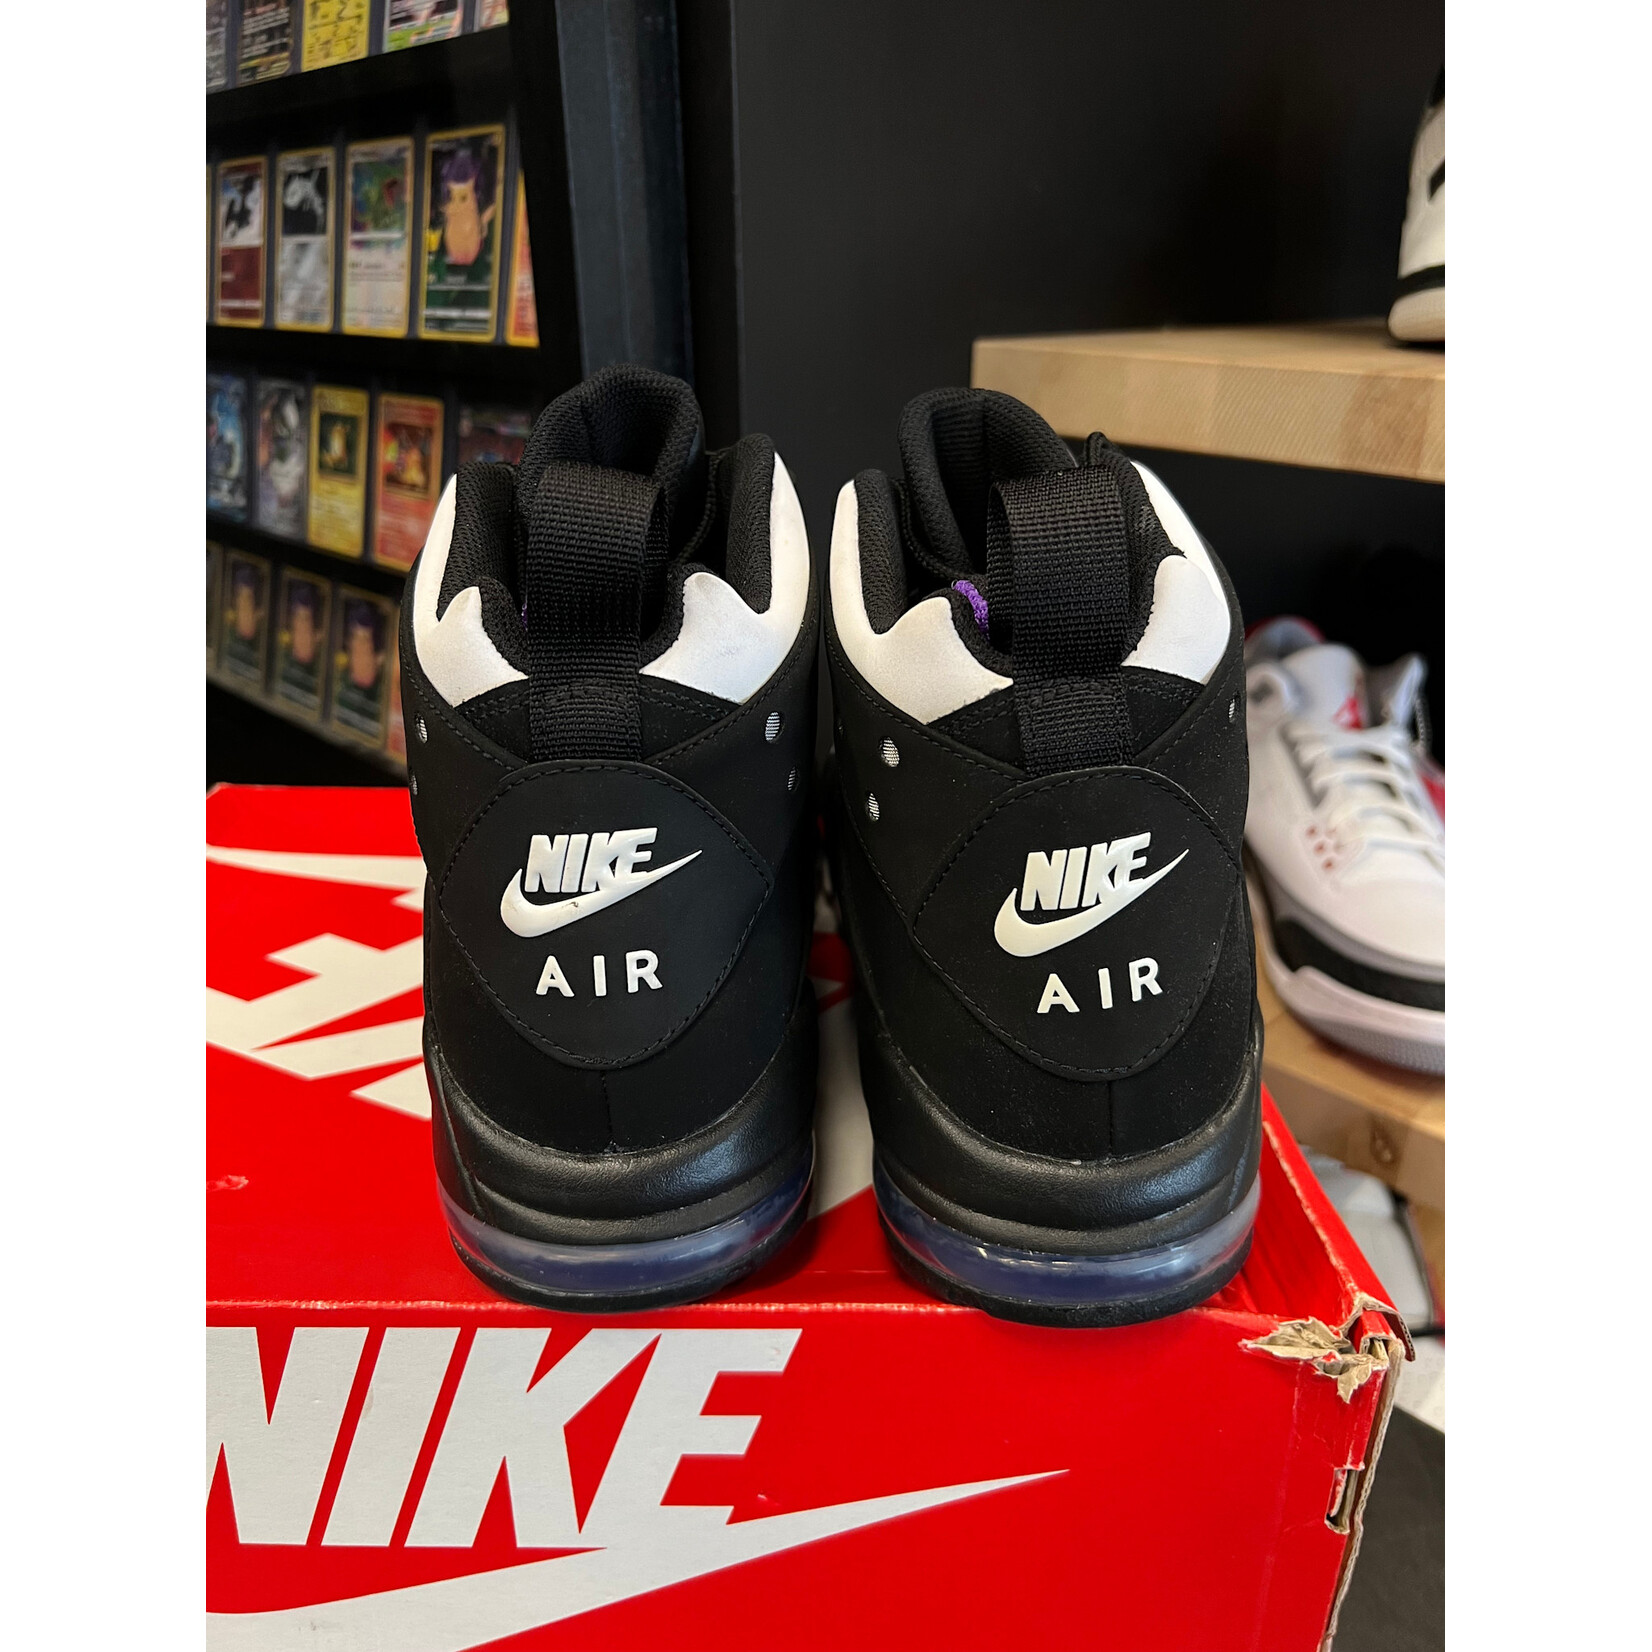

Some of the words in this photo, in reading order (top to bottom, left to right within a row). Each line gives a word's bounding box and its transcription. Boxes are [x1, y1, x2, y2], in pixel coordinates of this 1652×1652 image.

[524, 827, 658, 893] NIKE
[1020, 832, 1151, 911] NIKE
[535, 949, 663, 997] AIR
[1037, 957, 1163, 1014] AIR
[206, 1326, 802, 1549] NIKE
